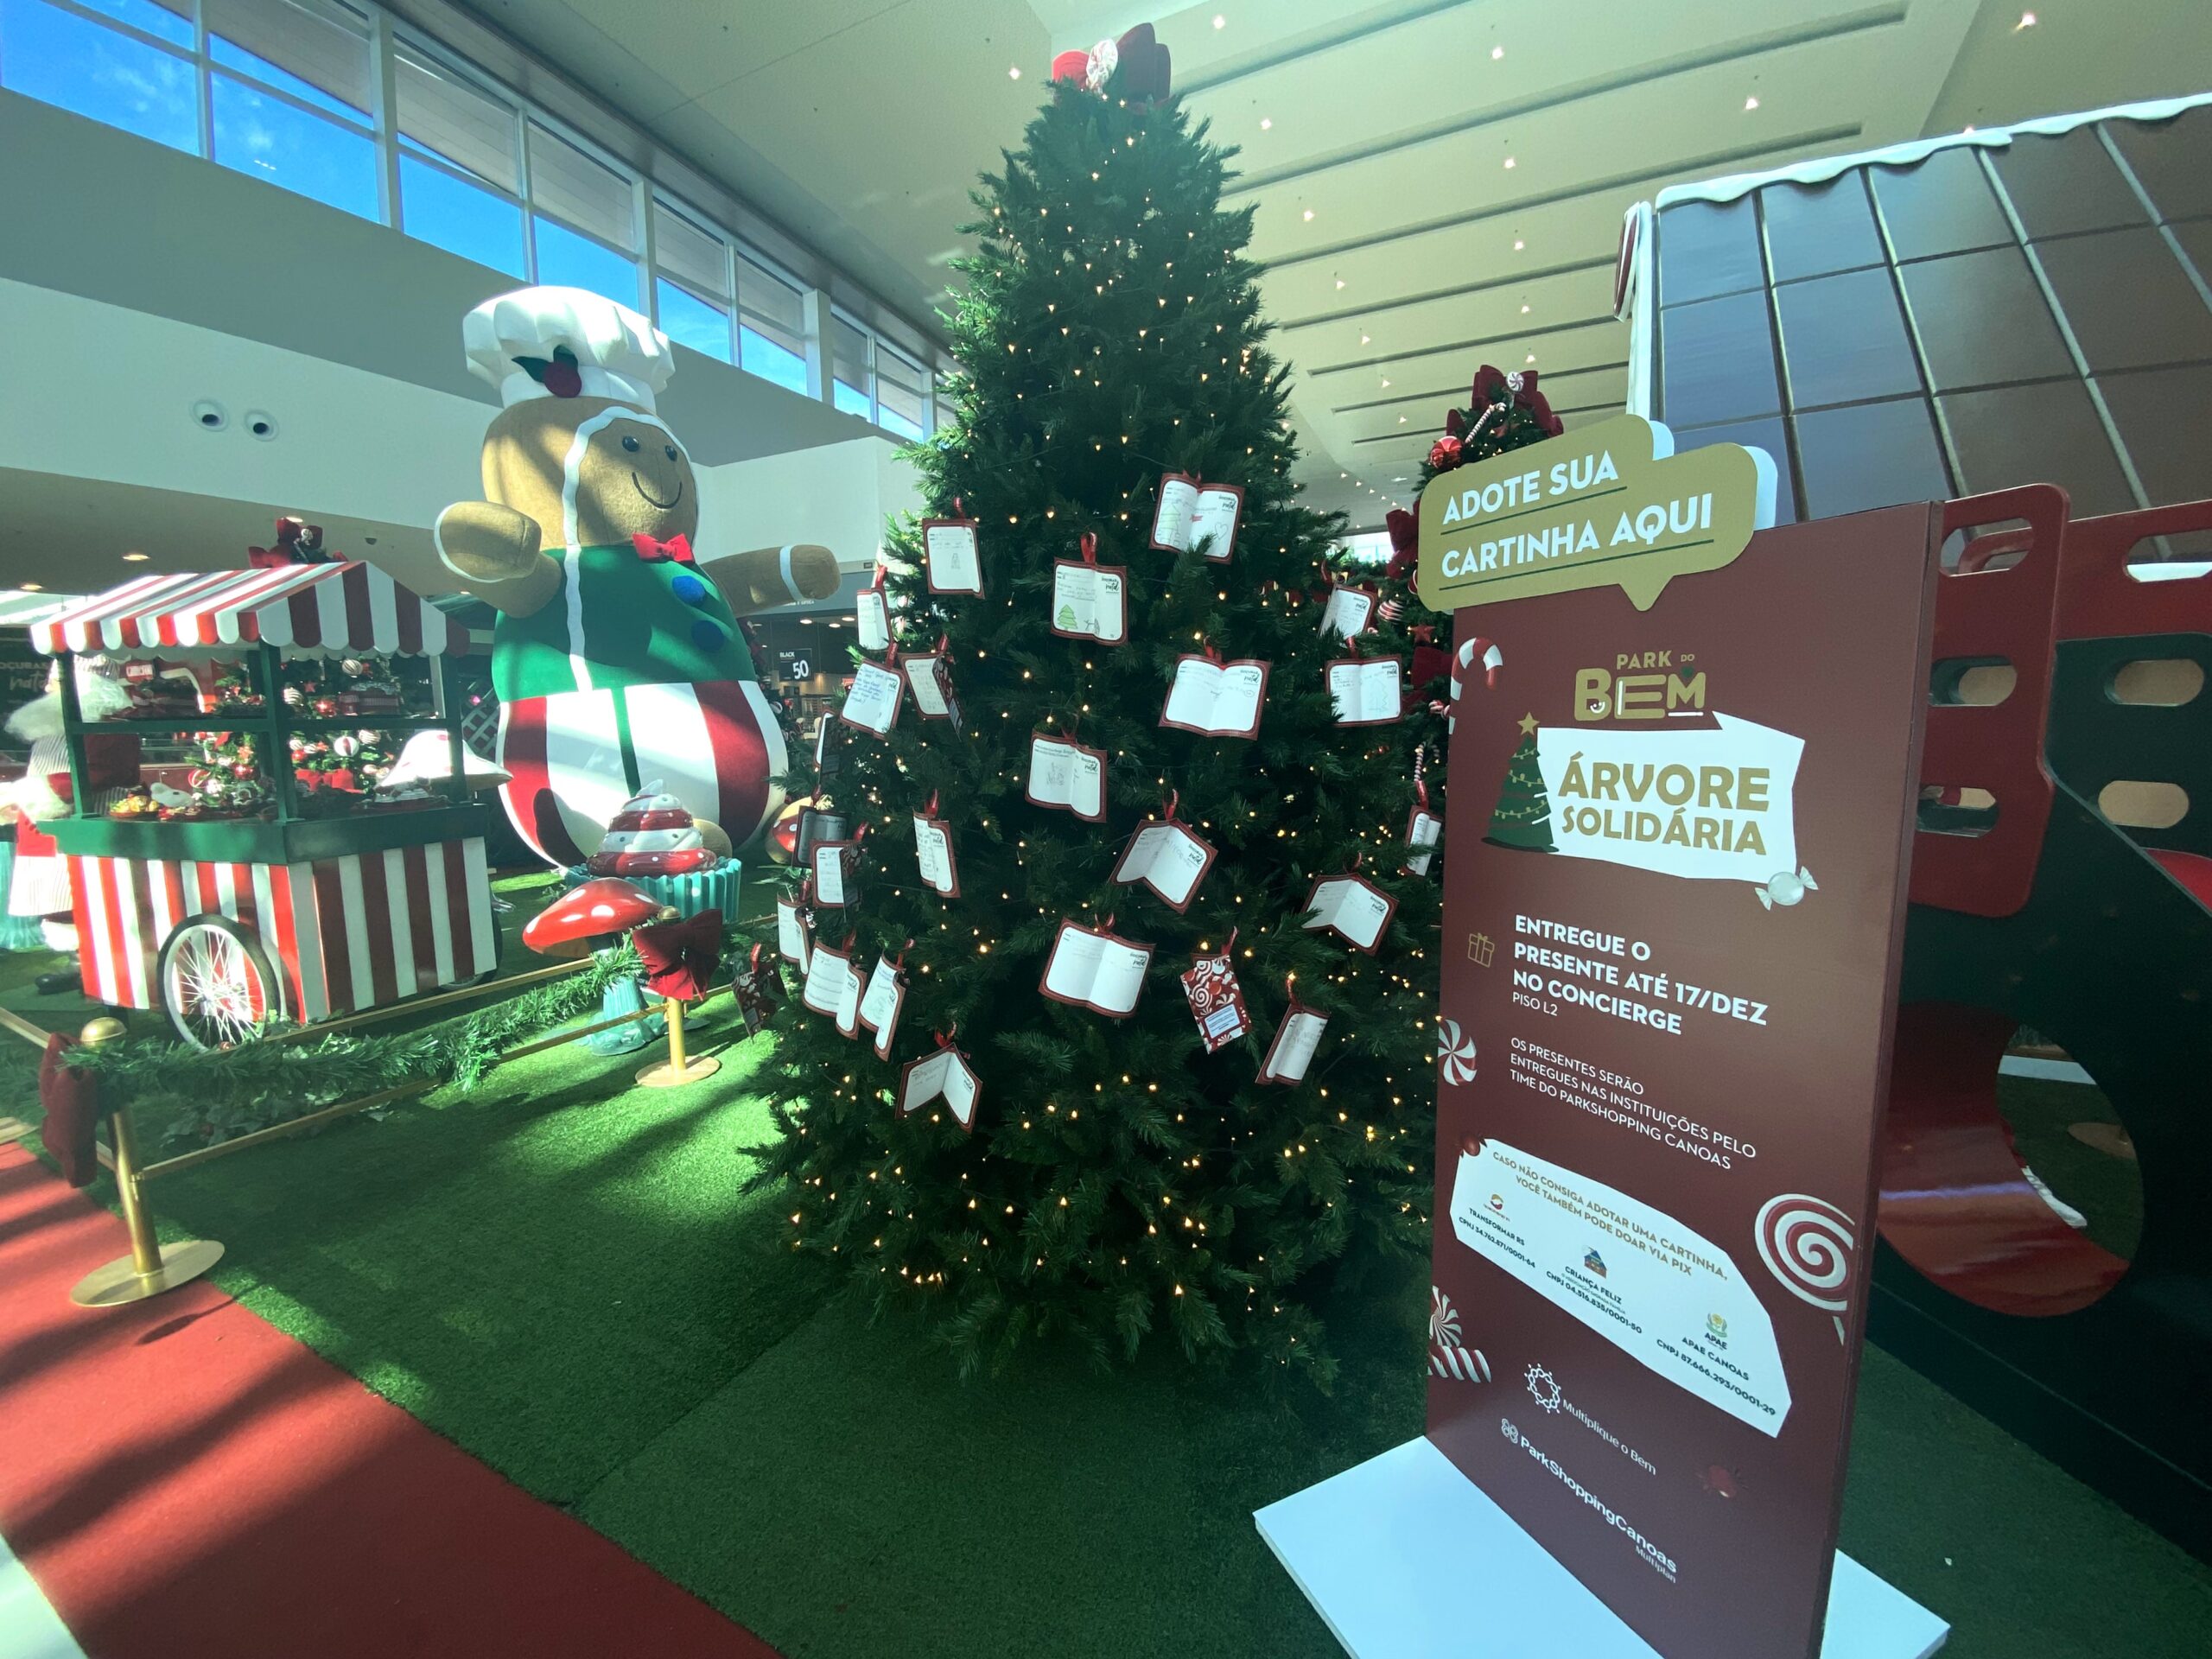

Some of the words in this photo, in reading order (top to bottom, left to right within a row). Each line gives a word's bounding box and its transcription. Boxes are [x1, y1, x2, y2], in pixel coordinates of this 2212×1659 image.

[1442, 470, 1541, 524] ADOTE
[1548, 450, 1618, 496] SUA
[1440, 518, 1600, 577] CARTINHA
[1610, 492, 1713, 545] AQUI
[792, 659, 809, 680] 50
[1616, 650, 1673, 671] PARK
[1681, 652, 1696, 663] DO
[1573, 667, 1707, 721] BEM
[1558, 751, 1771, 812] ÁRVORE
[1561, 805, 1767, 856] SOLIDÁRIA
[1514, 914, 1626, 957] ENTREGUE
[1630, 940, 1651, 962] O
[1512, 991, 1541, 1011] PISO
[1542, 1001, 1559, 1016] L2
[1513, 969, 1543, 992] NO
[1548, 979, 1683, 1035] CONCIERGE
[1514, 941, 1619, 986] PRESENTE
[1624, 972, 1669, 999] ATÉ
[1675, 982, 1769, 1026] 17/DEZ
[1510, 1036, 1527, 1052] OS
[1529, 1043, 1597, 1078] PRESENTES
[1599, 1069, 1645, 1096] SERÃO
[1510, 1052, 1579, 1090] ENTREGUES
[1580, 1081, 1608, 1101] NAS
[1610, 1091, 1710, 1141] INSTITUIÇÕES
[1713, 1130, 1757, 1159] PELO
[1510, 1068, 1537, 1090] TIME
[1538, 1080, 1558, 1097] DO
[1560, 1090, 1662, 1141] PARKSHOPPING
[1664, 1133, 1732, 1169] CANOAS
[1469, 1207, 1516, 1242] TRANSFORMAR
[1516, 1236, 1526, 1247] RS
[1492, 1152, 1517, 1170] CASO
[1518, 1165, 1540, 1181] NÃO
[1541, 1176, 1585, 1206] CONSIGA
[1586, 1200, 1630, 1229] ADOTAR
[1631, 1224, 1658, 1244] UMA
[1660, 1237, 1728, 1281] CARTINHA,
[1516, 1175, 1541, 1195] VOCÊ
[1542, 1189, 1583, 1218] TAMBÉM
[1584, 1212, 1614, 1234] PODE
[1615, 1229, 1647, 1252] DOAR
[1649, 1244, 1669, 1264] VIA
[1671, 1257, 1693, 1277] PIX
[1546, 1270, 1565, 1287] CNPJ
[1565, 1265, 1599, 1292] CRIANÇA
[1599, 1286, 1623, 1305] FELIZ
[1681, 1336, 1707, 1356] APAE
[1707, 1351, 1750, 1382] CANOAS
[1704, 1332, 1728, 1351] APAE
[1656, 1338, 1679, 1357] CNPJ
[1681, 1352, 1777, 1416] 87.666.293/0001-29
[1562, 1398, 1620, 1448] Multiplique
[1620, 1442, 1629, 1454] o
[1630, 1449, 1657, 1475] Bem
[1521, 1434, 1677, 1573] ParkShoppingCanoas
[1635, 1545, 1676, 1584] Multiplan
